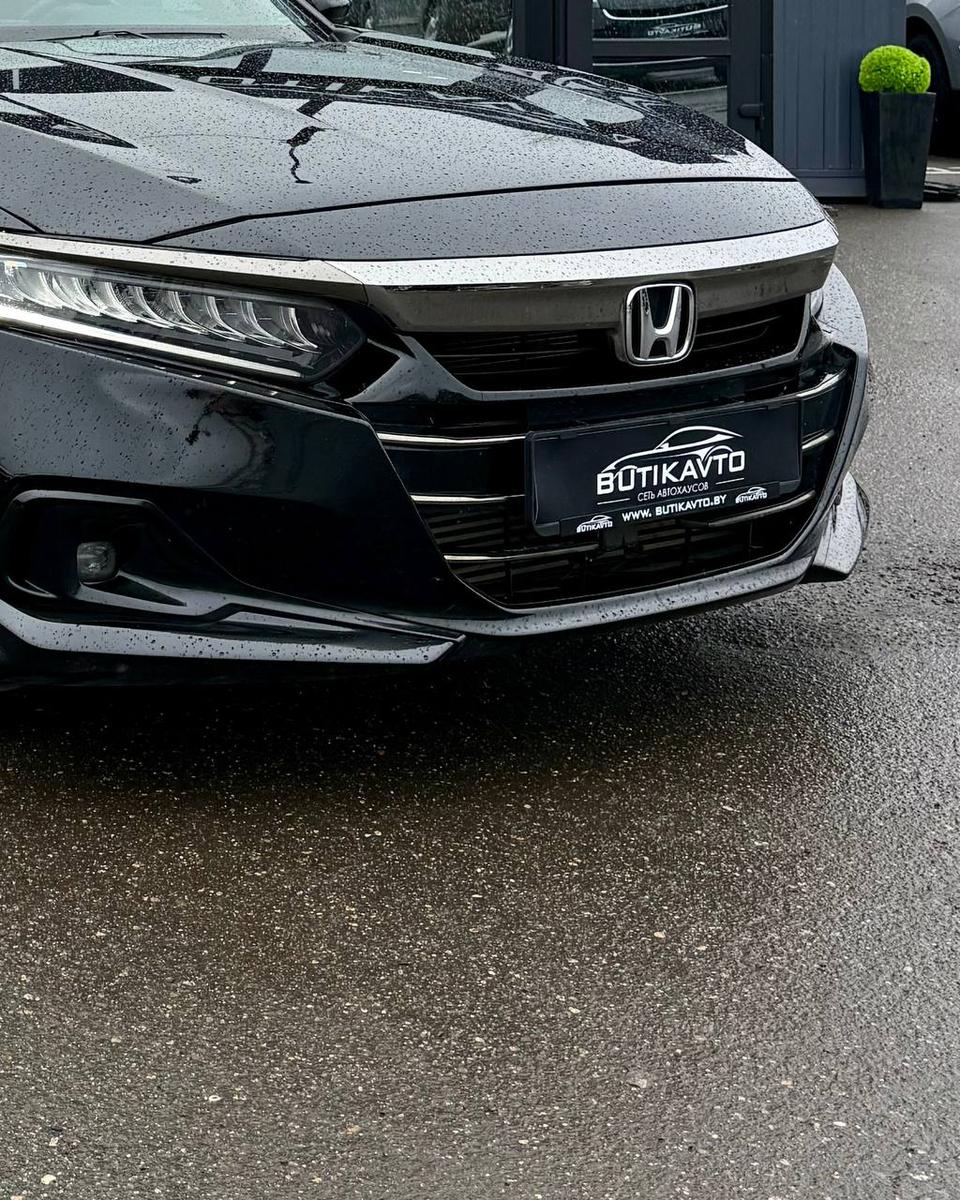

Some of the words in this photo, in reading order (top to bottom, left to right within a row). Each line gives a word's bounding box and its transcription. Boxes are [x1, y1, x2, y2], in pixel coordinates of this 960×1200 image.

[596, 450, 745, 495] BUTIKAVTO
[637, 490, 656, 502] СЕТЬ
[656, 482, 709, 498] АВТОХАУСОВ
[655, 494, 727, 517] BUTIKAVTO.BY
